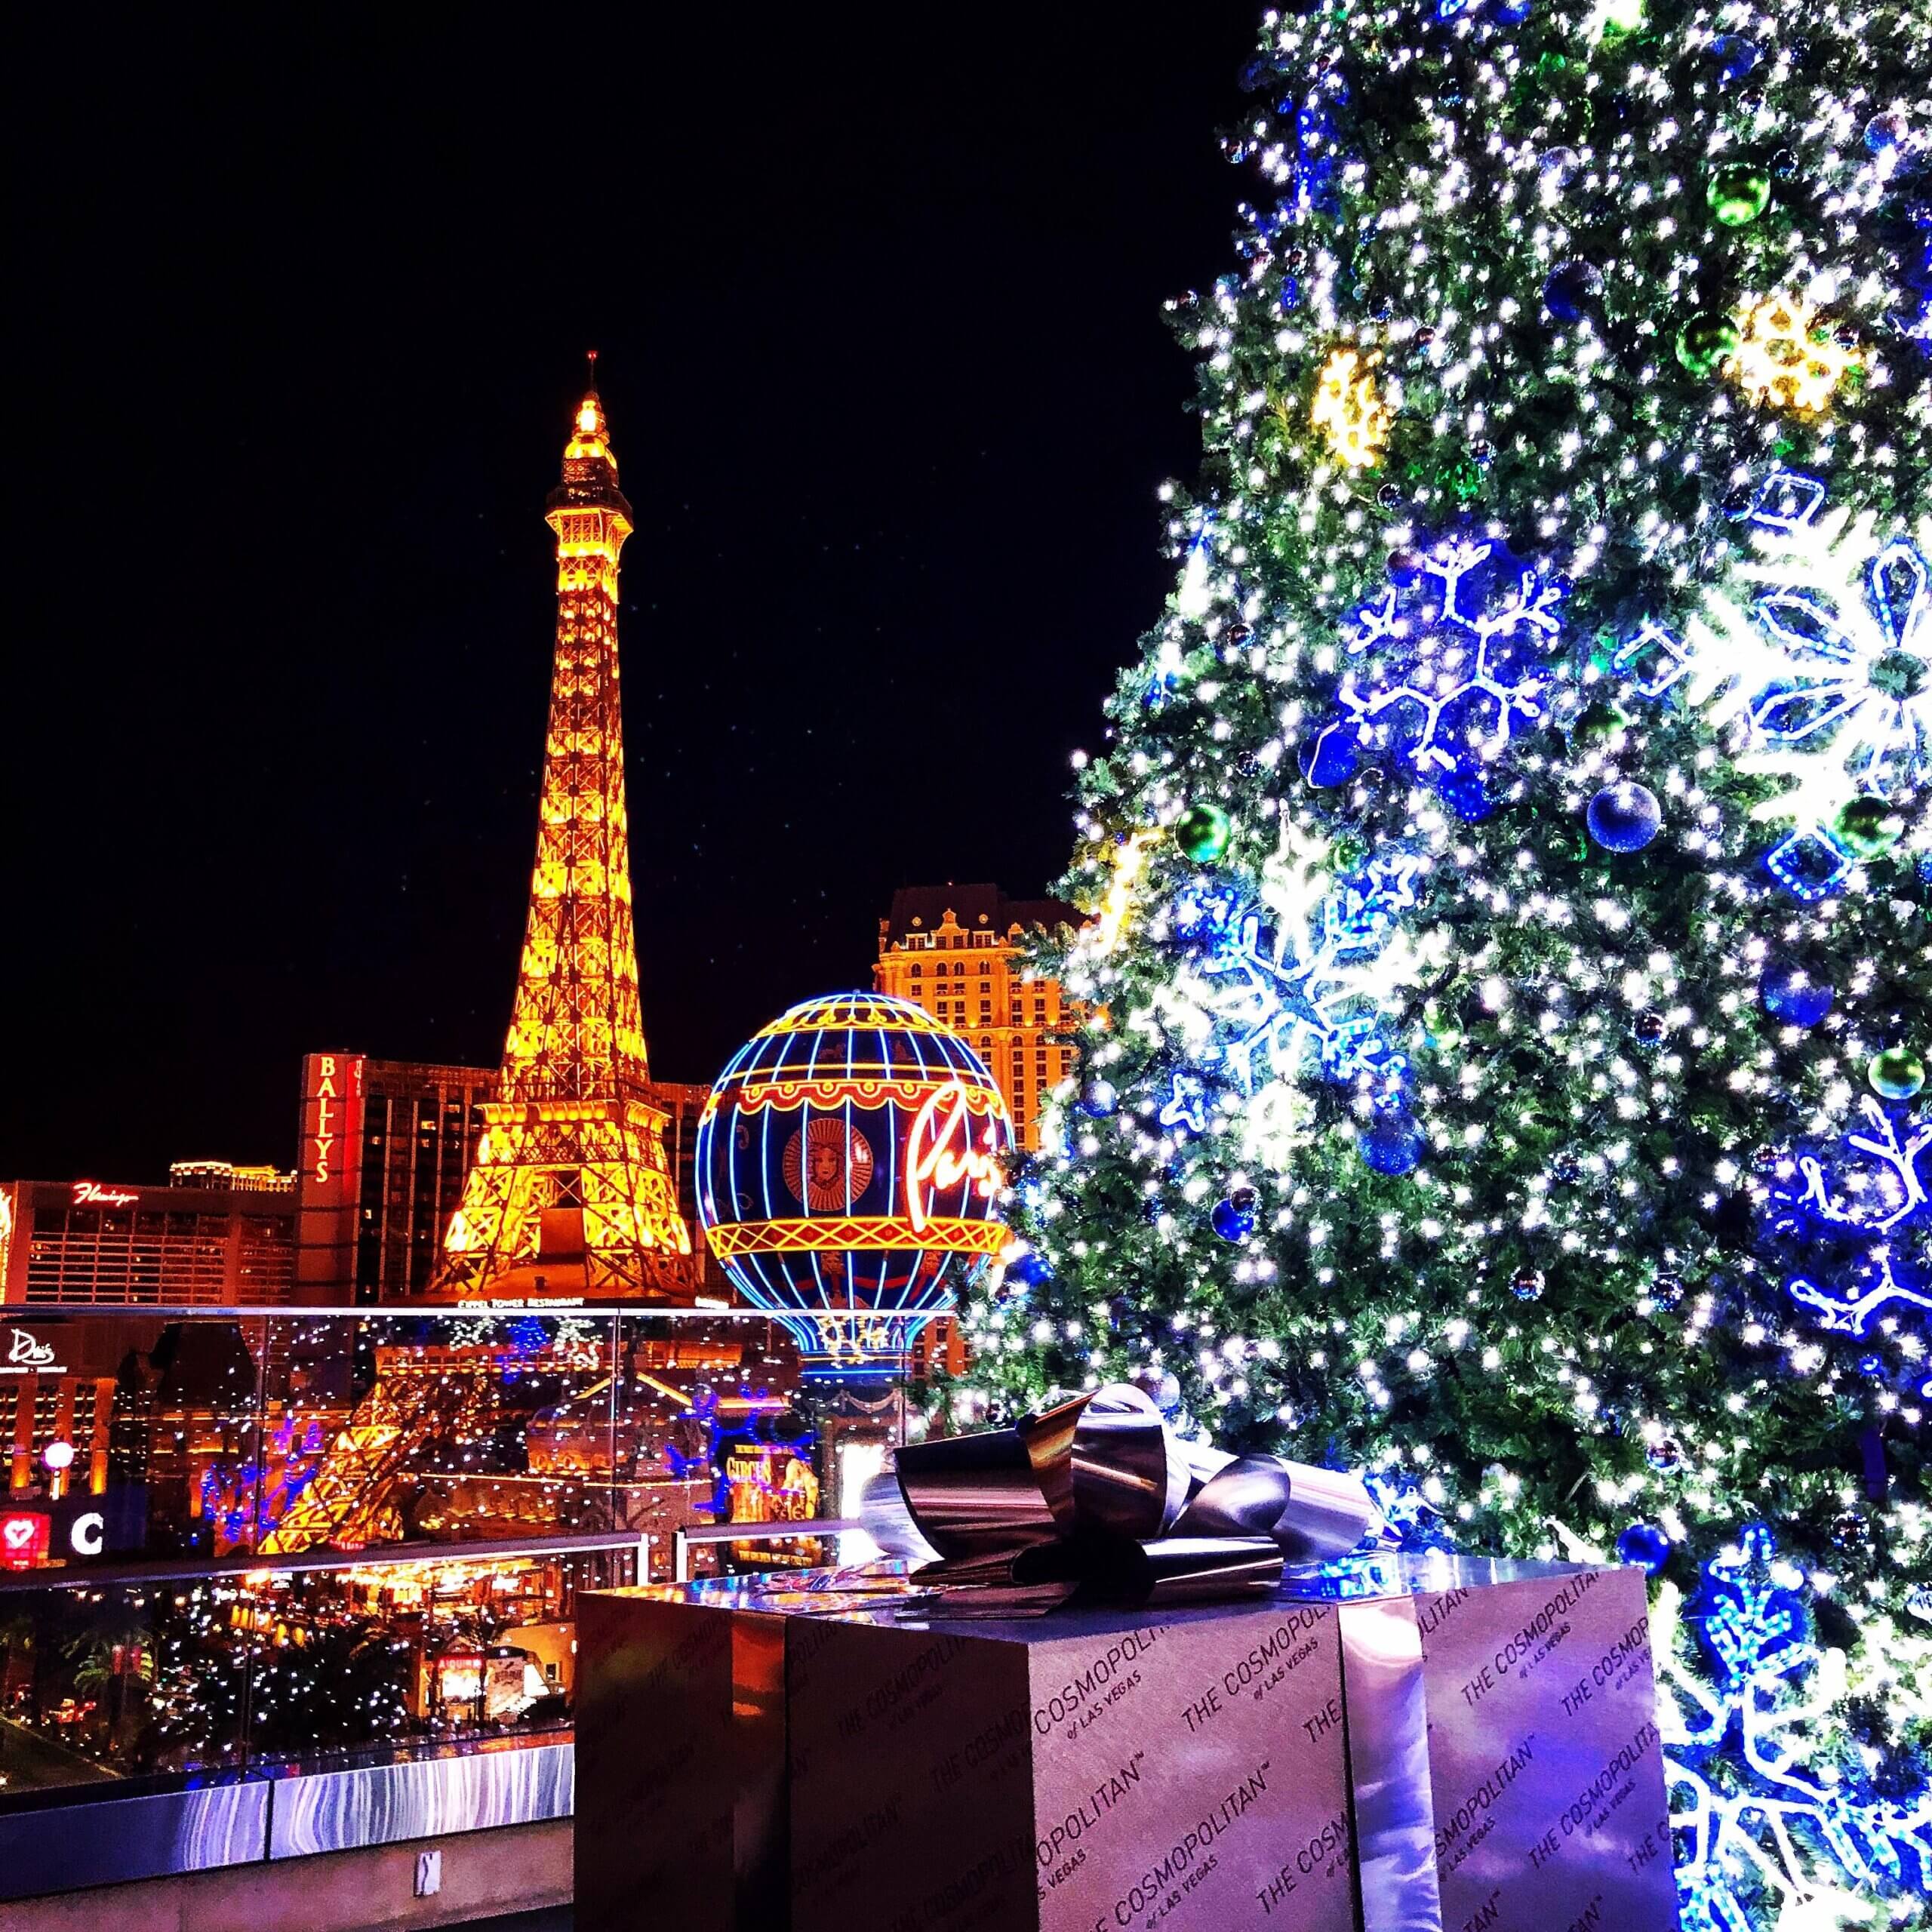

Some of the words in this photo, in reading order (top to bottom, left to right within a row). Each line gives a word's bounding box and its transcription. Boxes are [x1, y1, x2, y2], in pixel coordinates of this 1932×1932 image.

[315, 1057, 337, 1183] BALLYS
[906, 1079, 1002, 1233] Paris
[73, 1183, 140, 1208] Flamingo
[491, 1298, 525, 1308] TOWER
[1180, 1686, 1223, 1733] THE
[1223, 1605, 1331, 1696] COSMOPOL
[1264, 1666, 1284, 1691] LAS
[1285, 1637, 1318, 1670] VEGAS
[1067, 1721, 1078, 1740] of
[1079, 1703, 1103, 1728] LAS
[1104, 1669, 1142, 1706] VEGAS
[1461, 1666, 1495, 1707] THE
[1559, 1678, 1593, 1717] THE
[1301, 1699, 1342, 1743] THE
[1466, 1816, 1496, 1849] VEGAS
[1527, 1828, 1561, 1870] THE
[1047, 1848, 1087, 1889] VEGAS
[1158, 1890, 1182, 1917] LAS
[1182, 1854, 1218, 1894] VEGAS
[1255, 1865, 1297, 1915] THE
